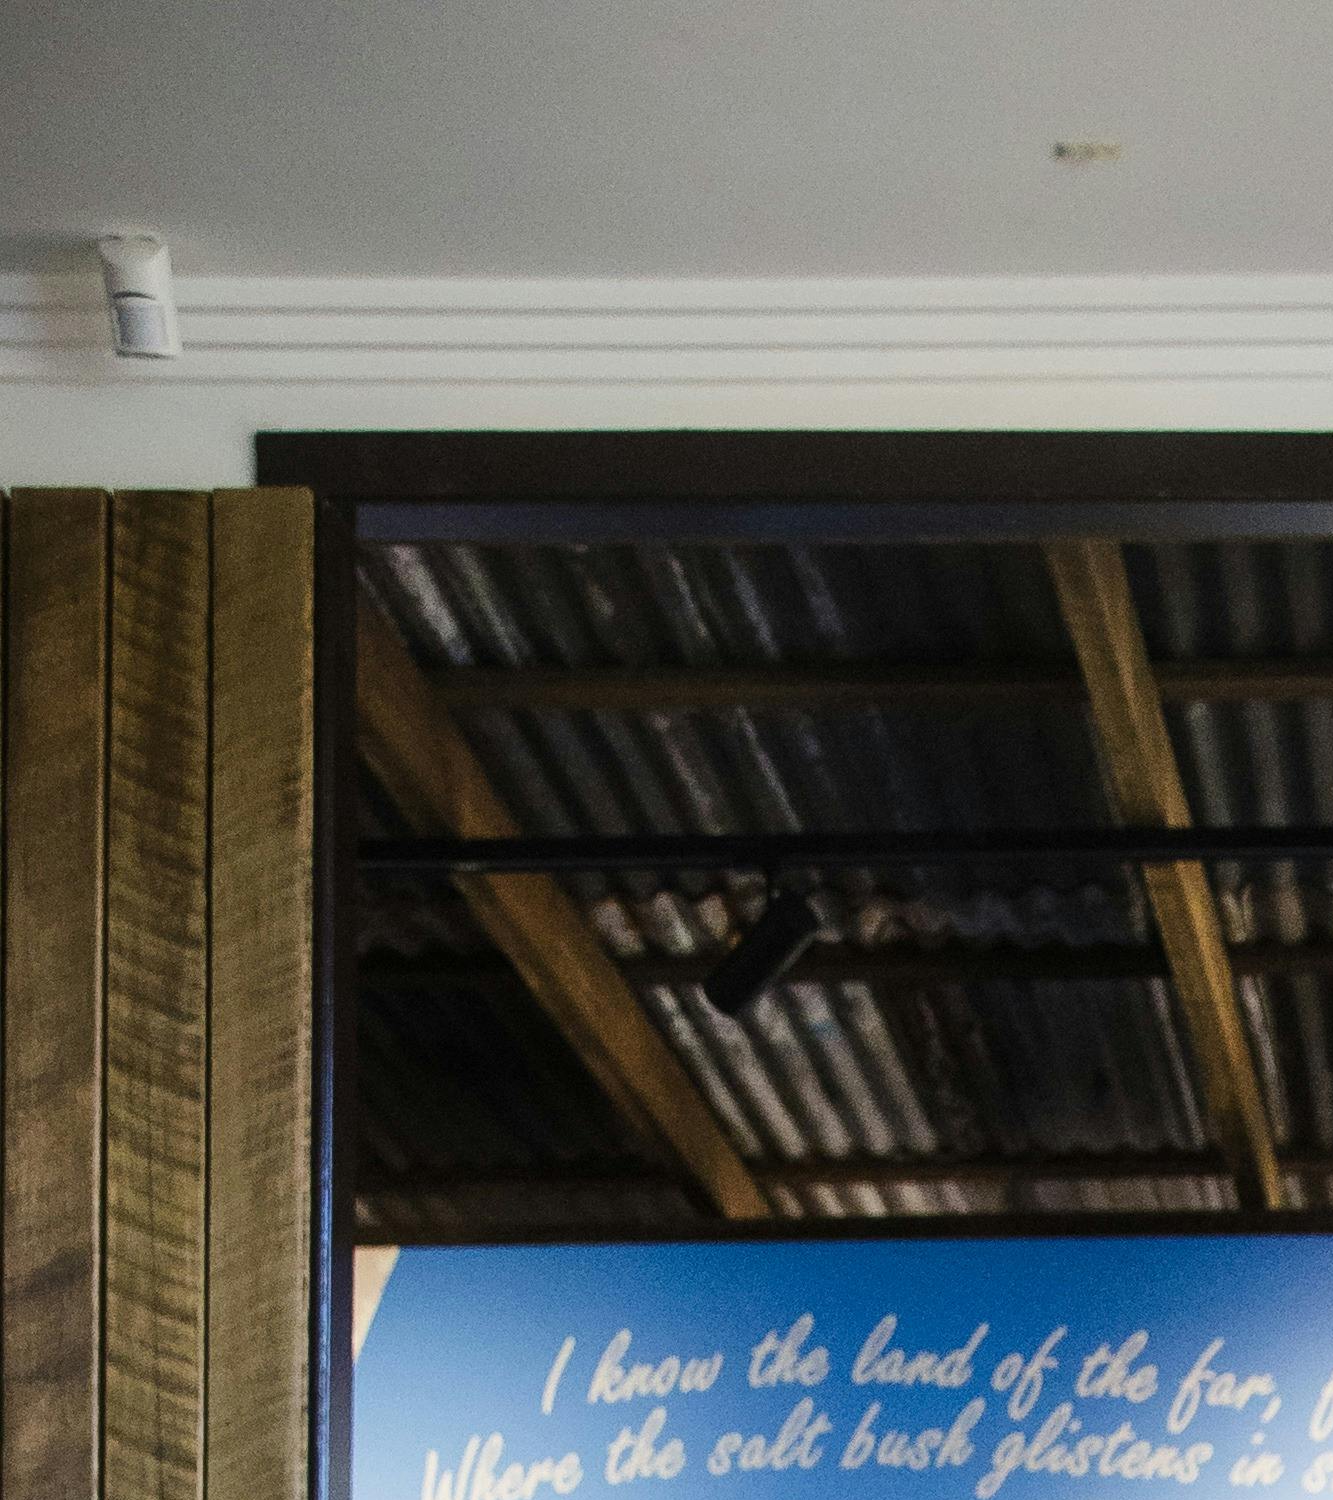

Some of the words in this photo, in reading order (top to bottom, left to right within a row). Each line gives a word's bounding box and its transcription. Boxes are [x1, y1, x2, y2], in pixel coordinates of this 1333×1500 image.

[540, 1337, 576, 1412] I
[587, 1331, 722, 1400] know
[748, 1313, 828, 1391] the
[850, 1311, 988, 1391] land
[989, 1322, 1069, 1410] of
[1076, 1328, 1162, 1400] the
[1167, 1334, 1283, 1426] far,
[604, 1408, 688, 1488] the
[707, 1396, 822, 1473] salt
[841, 1395, 974, 1468] bush
[977, 1401, 1215, 1500] glistens
[1229, 1418, 1286, 1490] in
